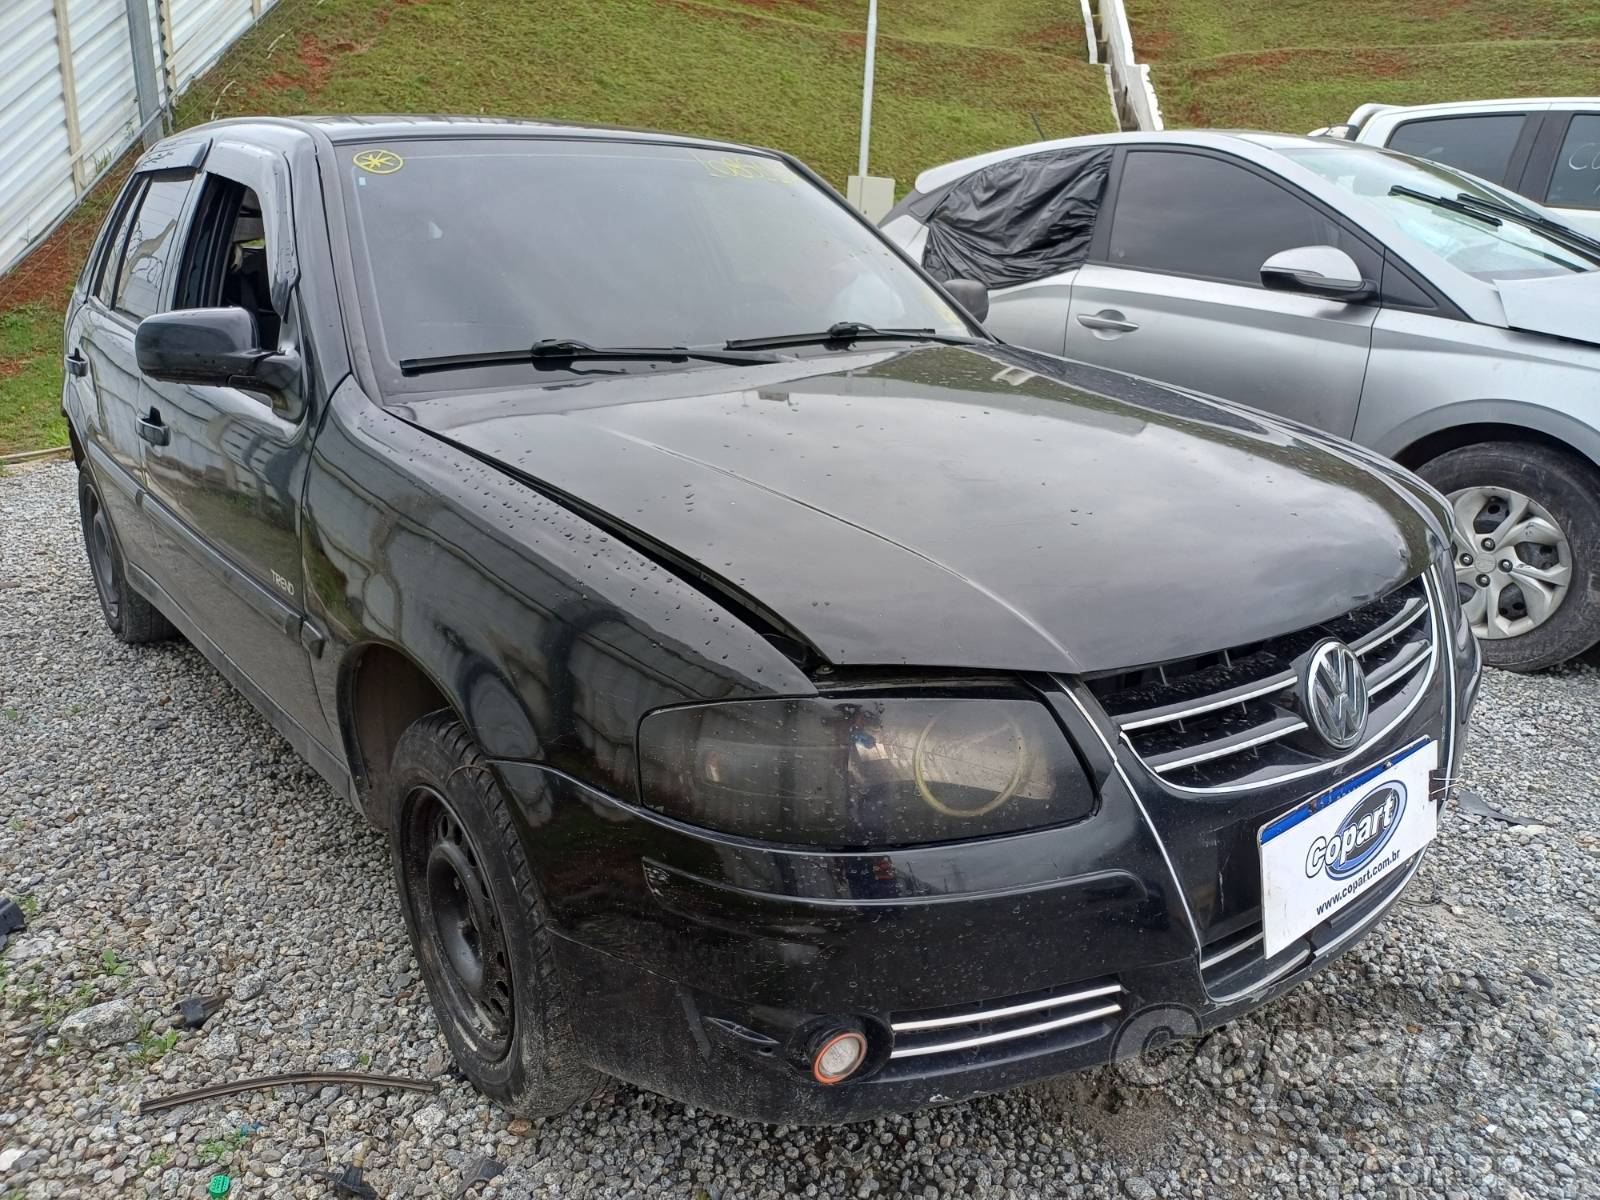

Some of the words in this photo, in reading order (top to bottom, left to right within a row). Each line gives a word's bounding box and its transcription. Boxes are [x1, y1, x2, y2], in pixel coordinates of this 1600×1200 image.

[270, 568, 295, 595] TREND
[1305, 791, 1396, 879] Copart
[1316, 850, 1400, 915] www.copart.com.br
